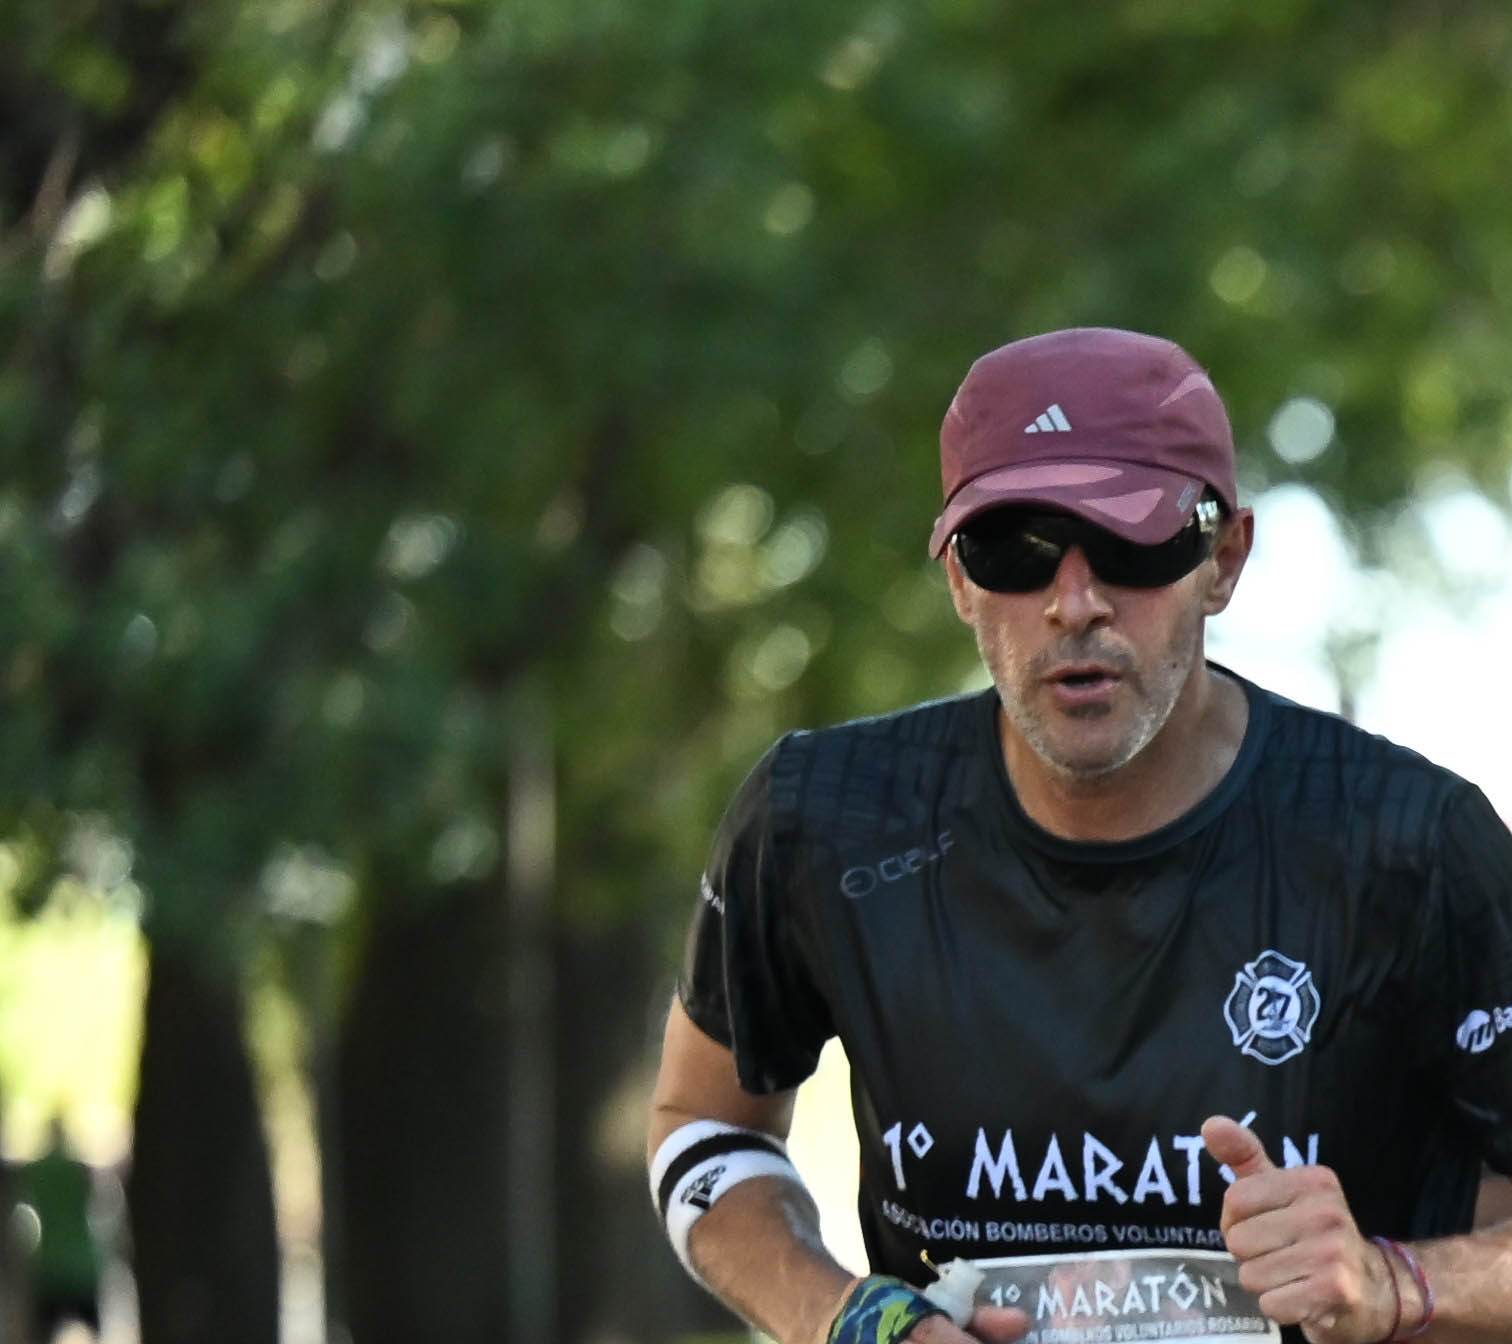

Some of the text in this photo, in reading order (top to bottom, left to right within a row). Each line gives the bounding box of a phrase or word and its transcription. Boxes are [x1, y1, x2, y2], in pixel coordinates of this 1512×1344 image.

[1256, 987, 1292, 1021] 27
[985, 1220, 1108, 1243] BOMBEROS
[1036, 1263, 1228, 1321] MARATÓN
